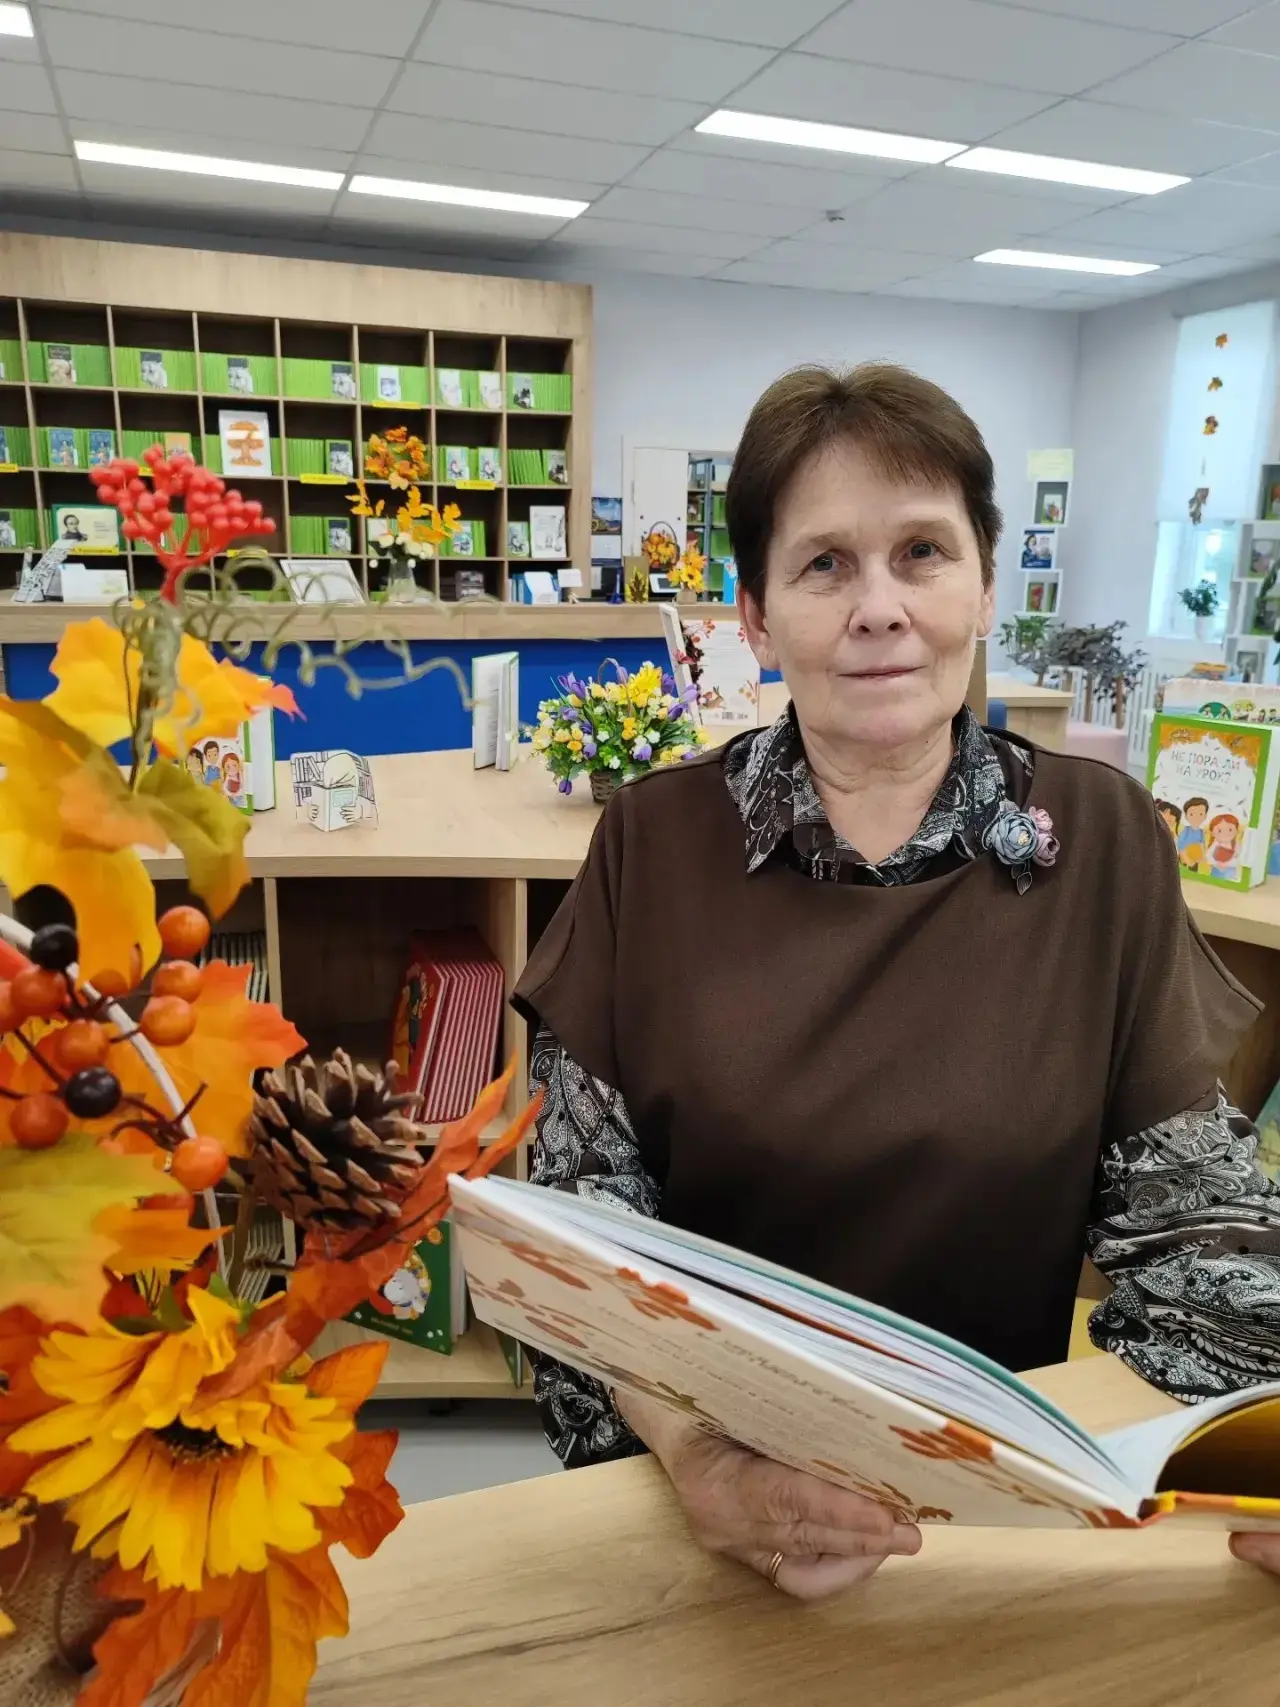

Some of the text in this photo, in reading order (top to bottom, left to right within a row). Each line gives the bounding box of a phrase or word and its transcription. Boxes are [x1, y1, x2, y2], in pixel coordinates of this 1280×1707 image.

[1171, 750, 1241, 770] НЕ ПОРА ЛИ
[1176, 764, 1232, 783] НА УРОК?
